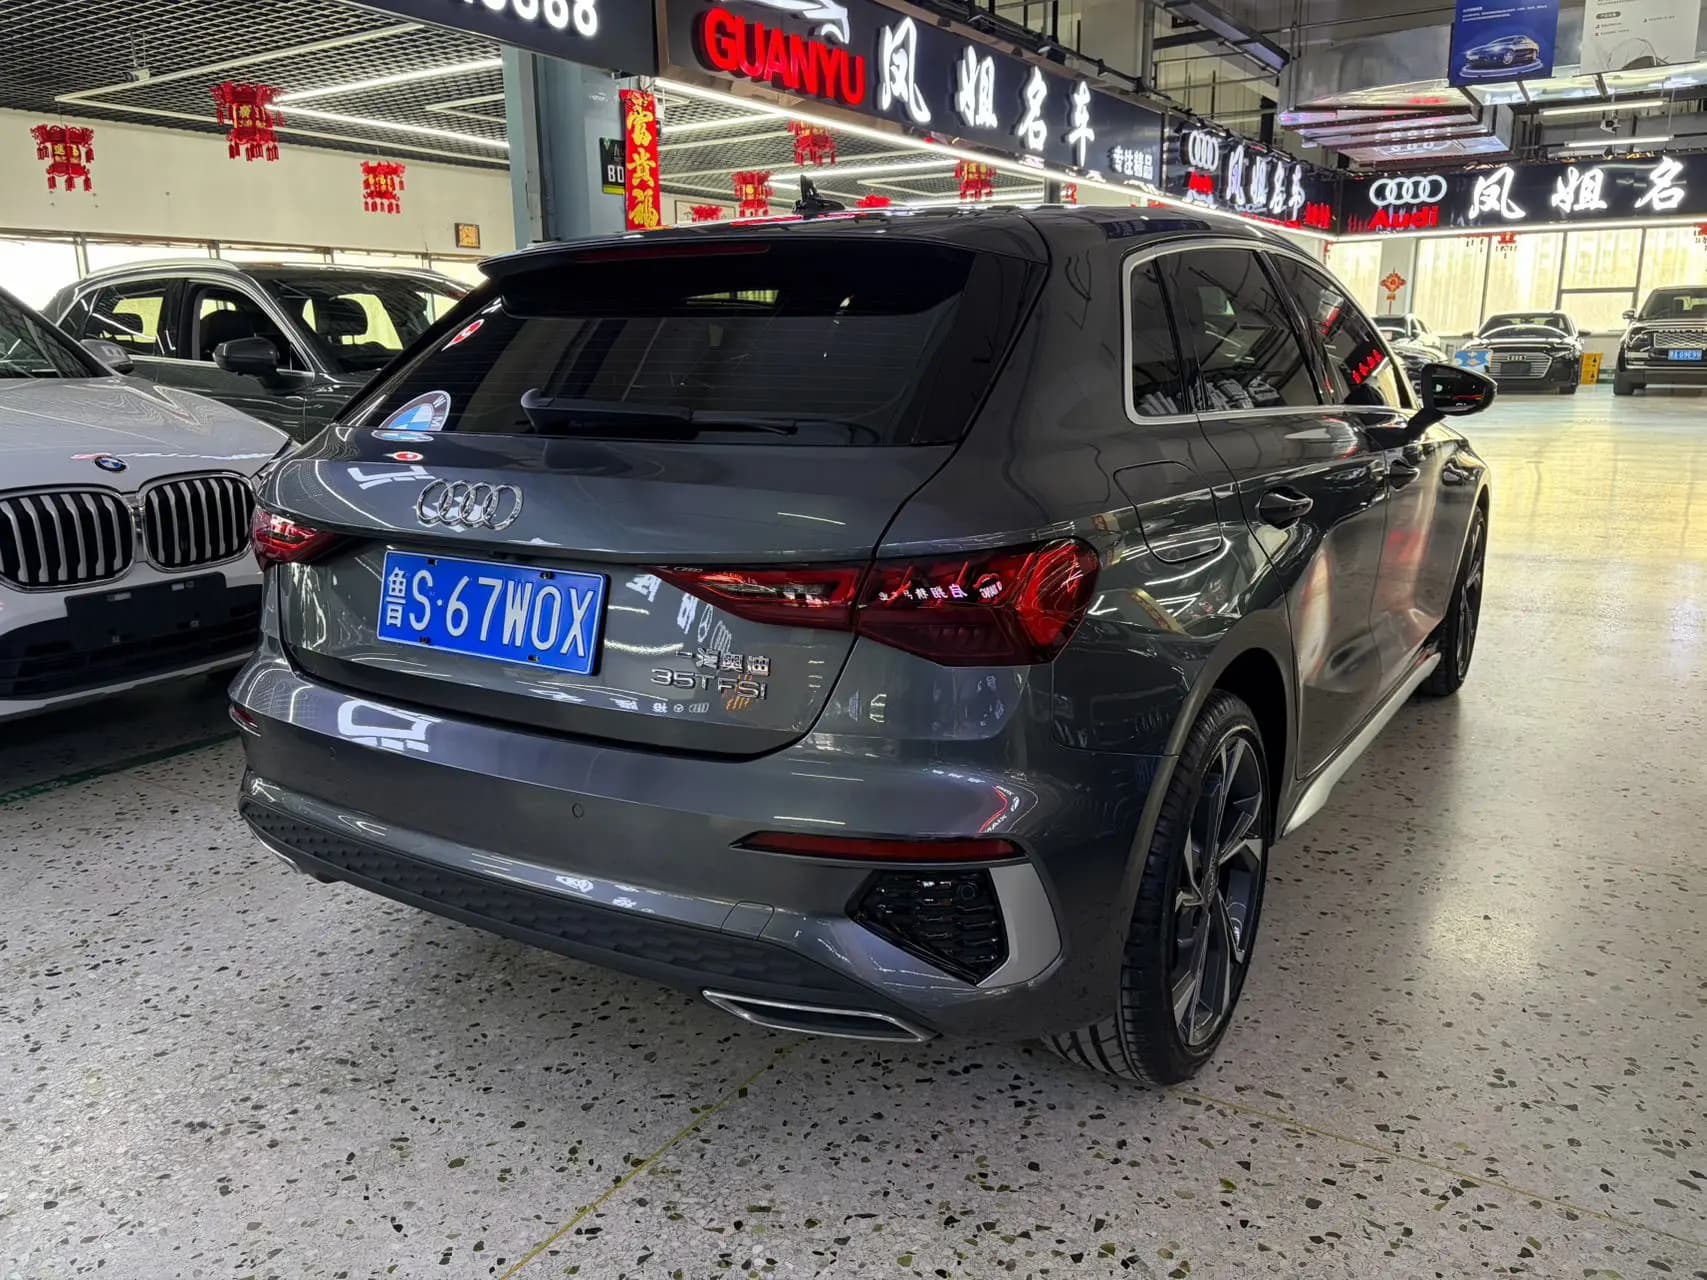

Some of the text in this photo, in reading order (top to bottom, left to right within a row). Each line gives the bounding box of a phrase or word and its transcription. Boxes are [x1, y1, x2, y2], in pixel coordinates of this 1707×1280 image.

[704, 7, 865, 106] GUANYU
[878, 16, 1096, 166] 凤姐名车
[1368, 204, 1440, 231] Audi
[1468, 156, 1687, 220] 凤姐名
[675, 648, 770, 676] 一汽奥迪
